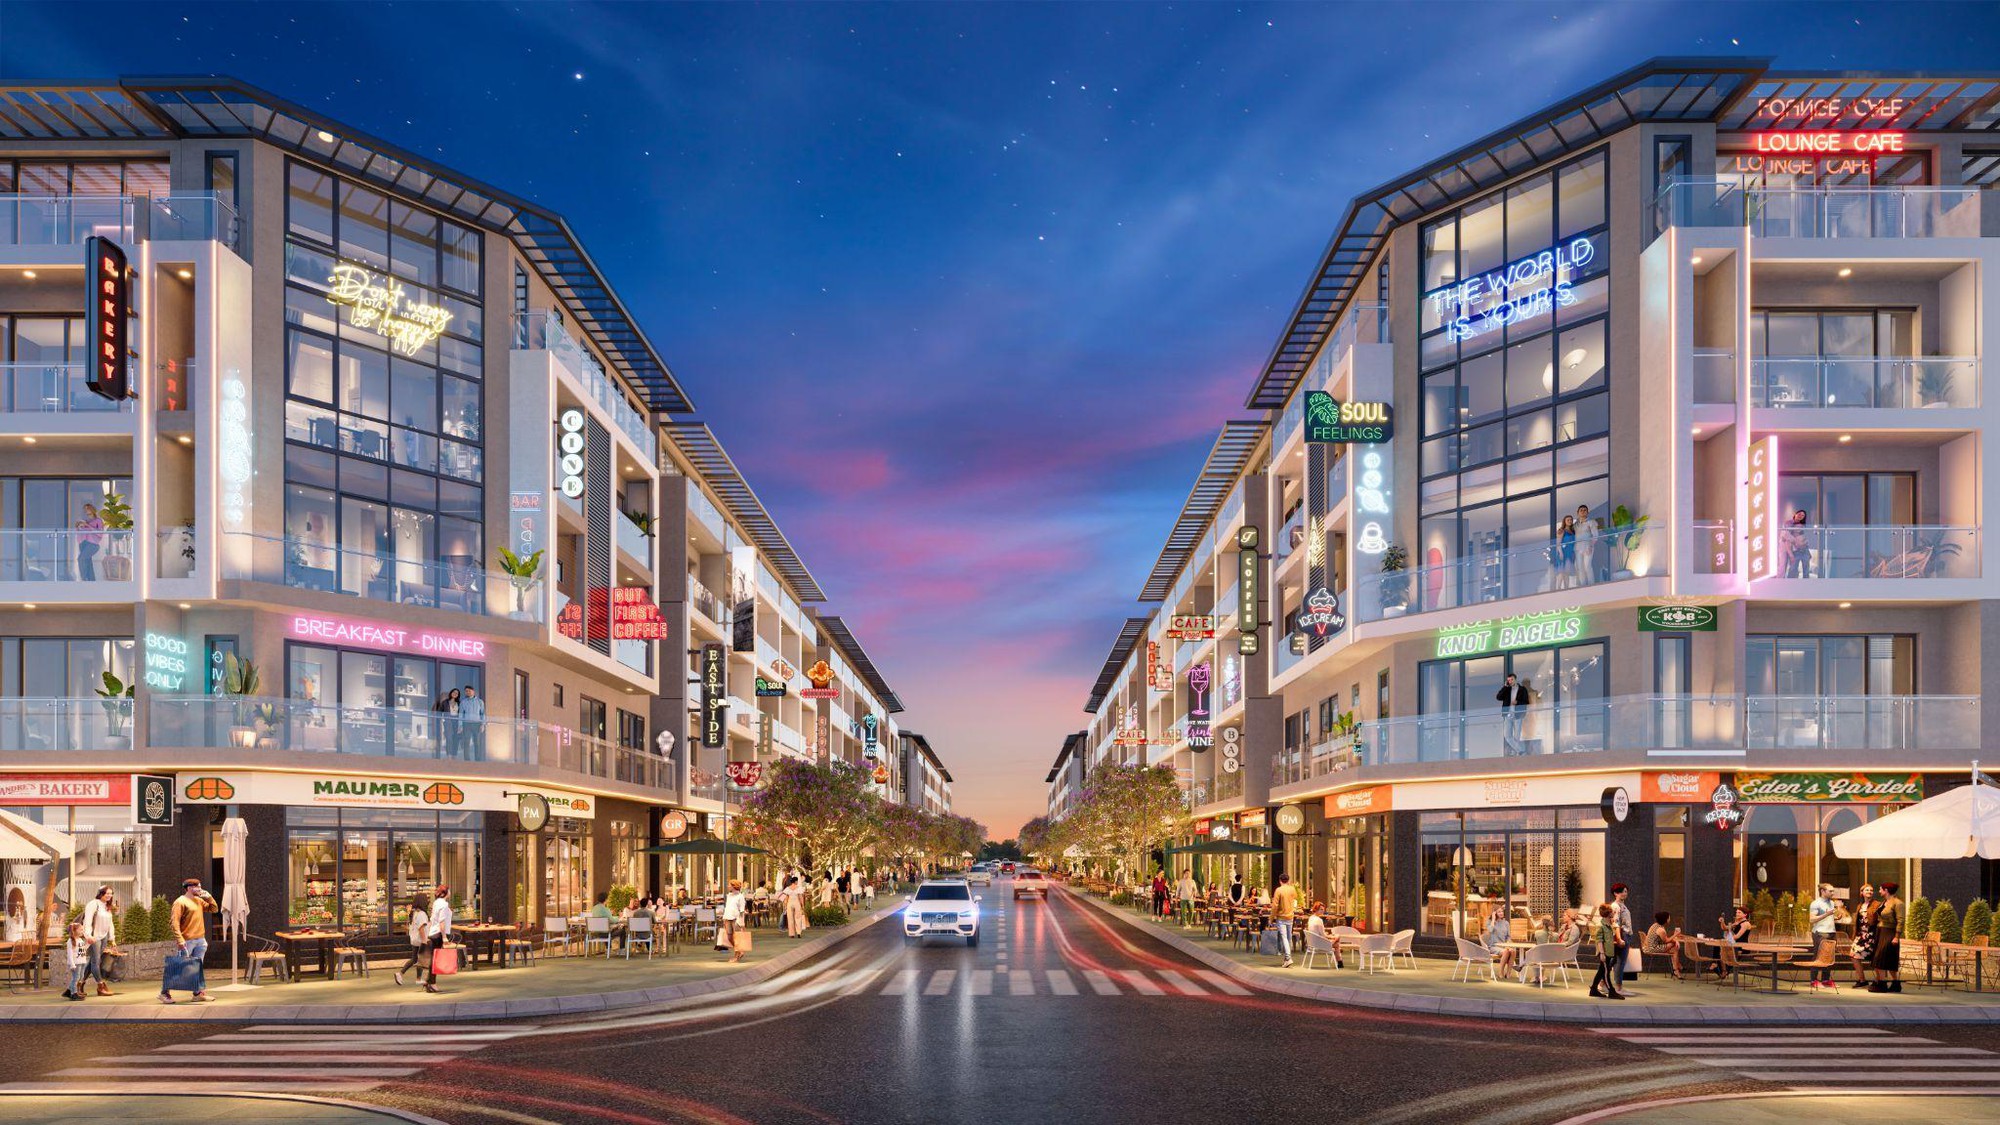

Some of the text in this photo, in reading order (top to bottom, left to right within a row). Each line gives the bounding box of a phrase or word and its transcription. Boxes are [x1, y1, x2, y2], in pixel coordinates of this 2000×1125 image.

[1758, 134, 1903, 151] LOUNGE CAFE
[1429, 238, 1592, 317] THE WORLD
[103, 256, 119, 379] BAKERY
[1447, 281, 1573, 341] IS YOURS
[1341, 402, 1388, 421] SOUL
[1313, 427, 1383, 440] FEELINGS
[567, 415, 578, 492] CINE
[512, 495, 539, 508] BAR
[1752, 449, 1764, 573] COFFEE
[614, 588, 643, 603] BUT
[1244, 557, 1253, 623] COFFEE
[294, 616, 408, 647] BREAKFAST
[614, 622, 668, 639] COFFEE
[1174, 618, 1209, 628] CAFE
[145, 632, 187, 655] GOOD
[1436, 630, 1492, 657] KNOT
[1499, 616, 1581, 648] BAGELS
[145, 651, 186, 673] VIBES
[708, 649, 719, 694] EAST
[145, 671, 183, 691] ONLY
[709, 698, 720, 743] SIDE
[1186, 736, 1215, 747] WINE
[1226, 730, 1236, 767] BAR
[1670, 783, 1700, 793] Cloud
[1671, 773, 1700, 785] Sugar
[1740, 778, 1918, 799] Eden's Garden
[39, 783, 103, 796] BAKERY
[523, 806, 540, 819] PM
[1281, 814, 1299, 825] PM
[664, 820, 683, 829] GR
